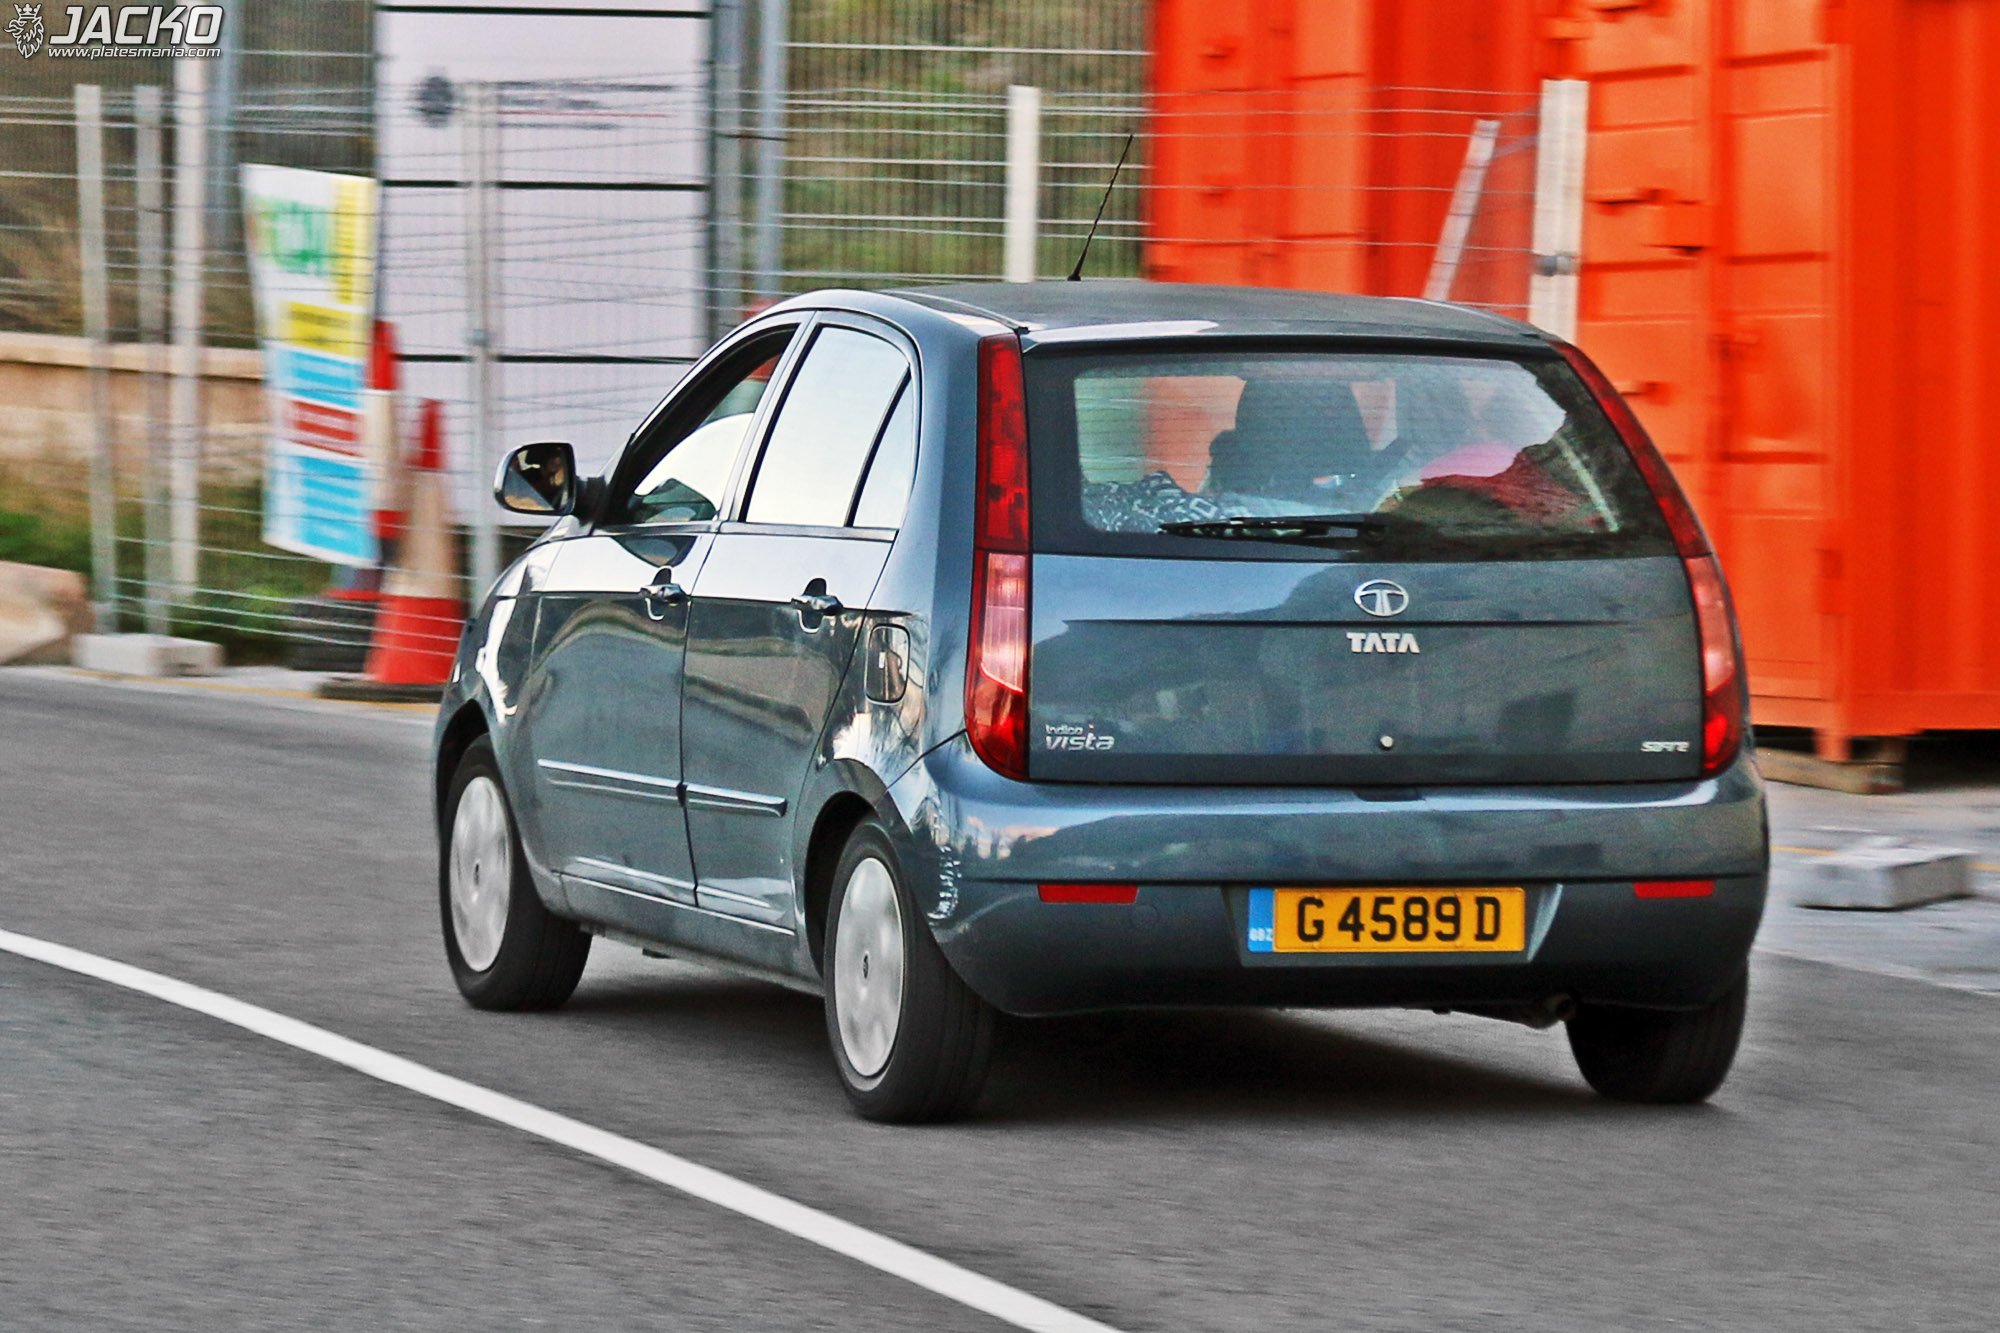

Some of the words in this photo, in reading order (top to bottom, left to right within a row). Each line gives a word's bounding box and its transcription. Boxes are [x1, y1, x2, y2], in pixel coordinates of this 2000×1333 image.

[1346, 632, 1420, 654] TATA
[1297, 896, 1324, 942] G
[1337, 896, 1461, 942] 4589
[1475, 896, 1501, 942] D
